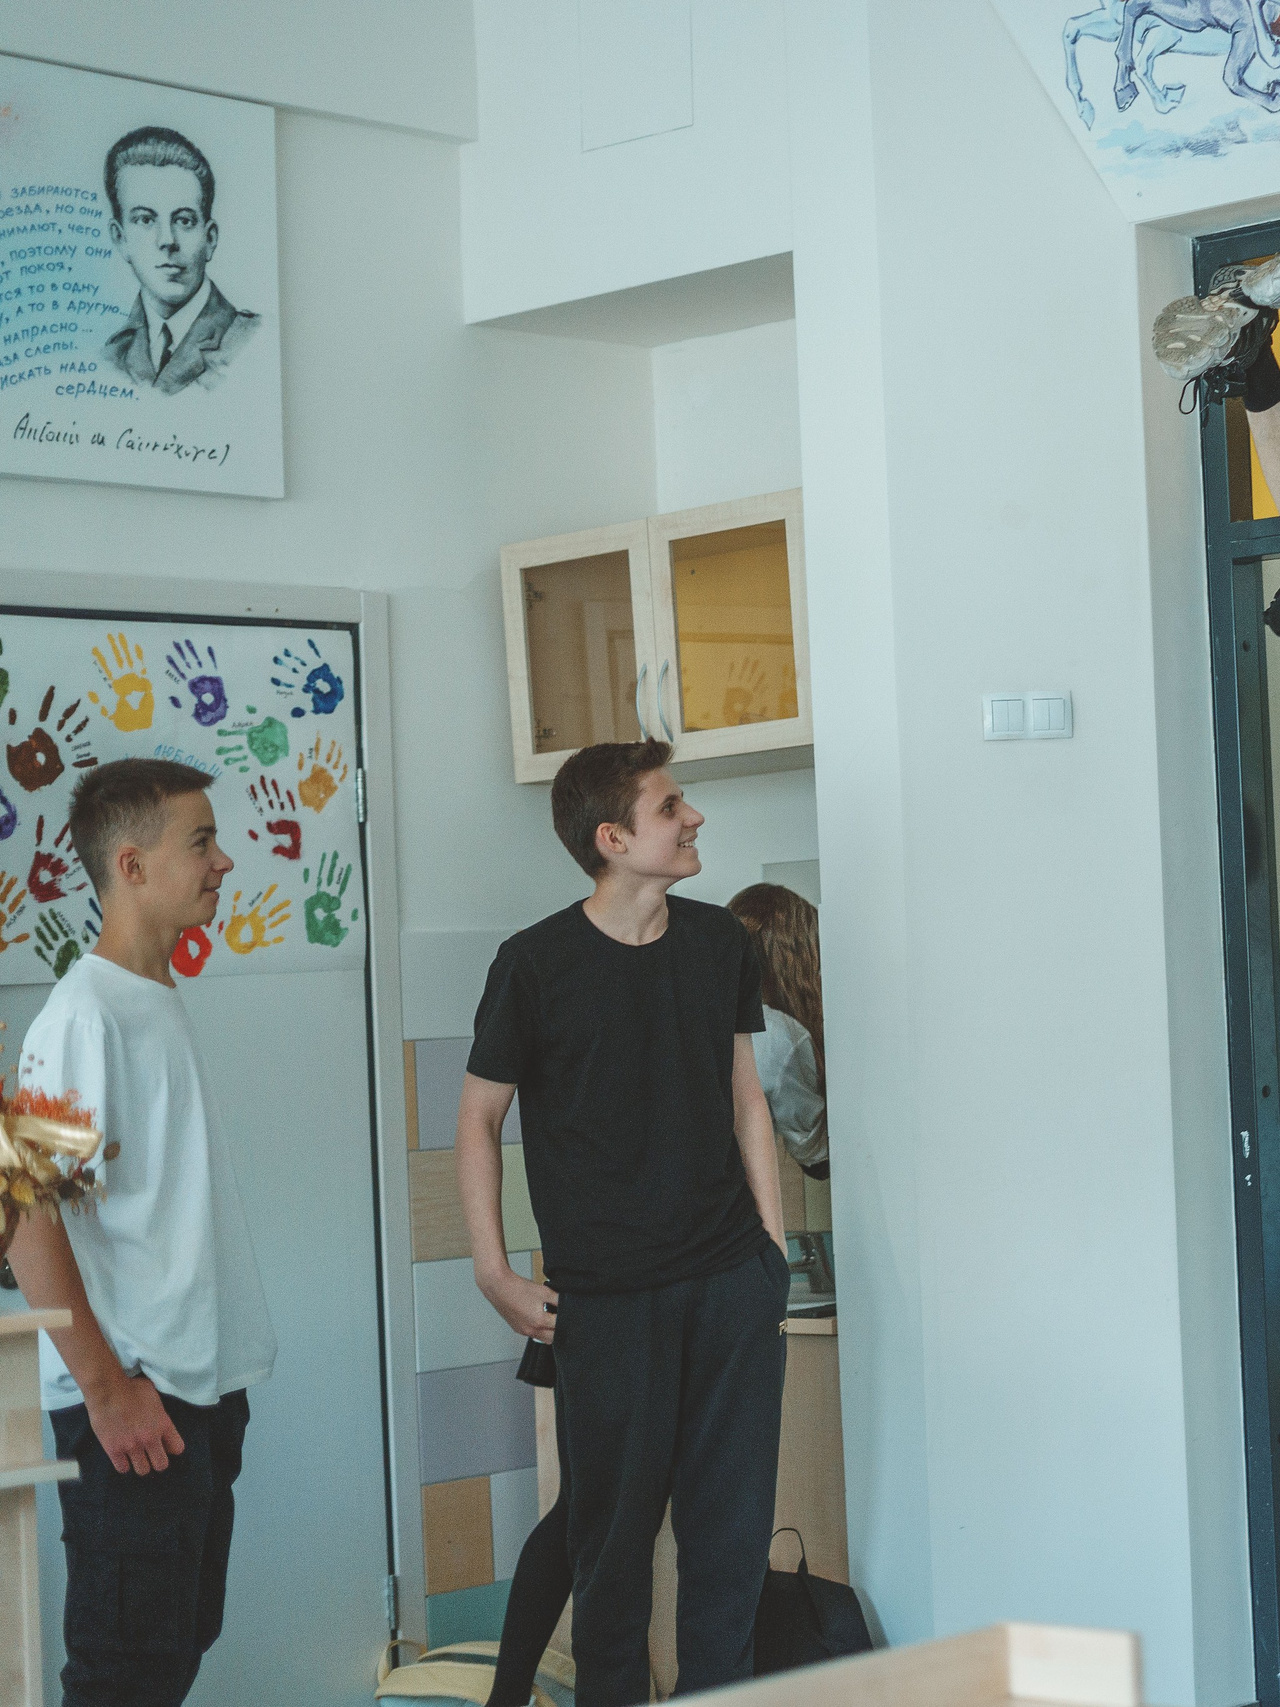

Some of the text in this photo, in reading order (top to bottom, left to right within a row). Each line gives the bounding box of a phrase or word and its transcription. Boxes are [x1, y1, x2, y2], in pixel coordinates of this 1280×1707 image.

[11, 185, 98, 201] ЗАБИРАЮТСЯ
[9, 245, 77, 260] ПОЭТОМУ
[59, 362, 97, 374] НАДО
